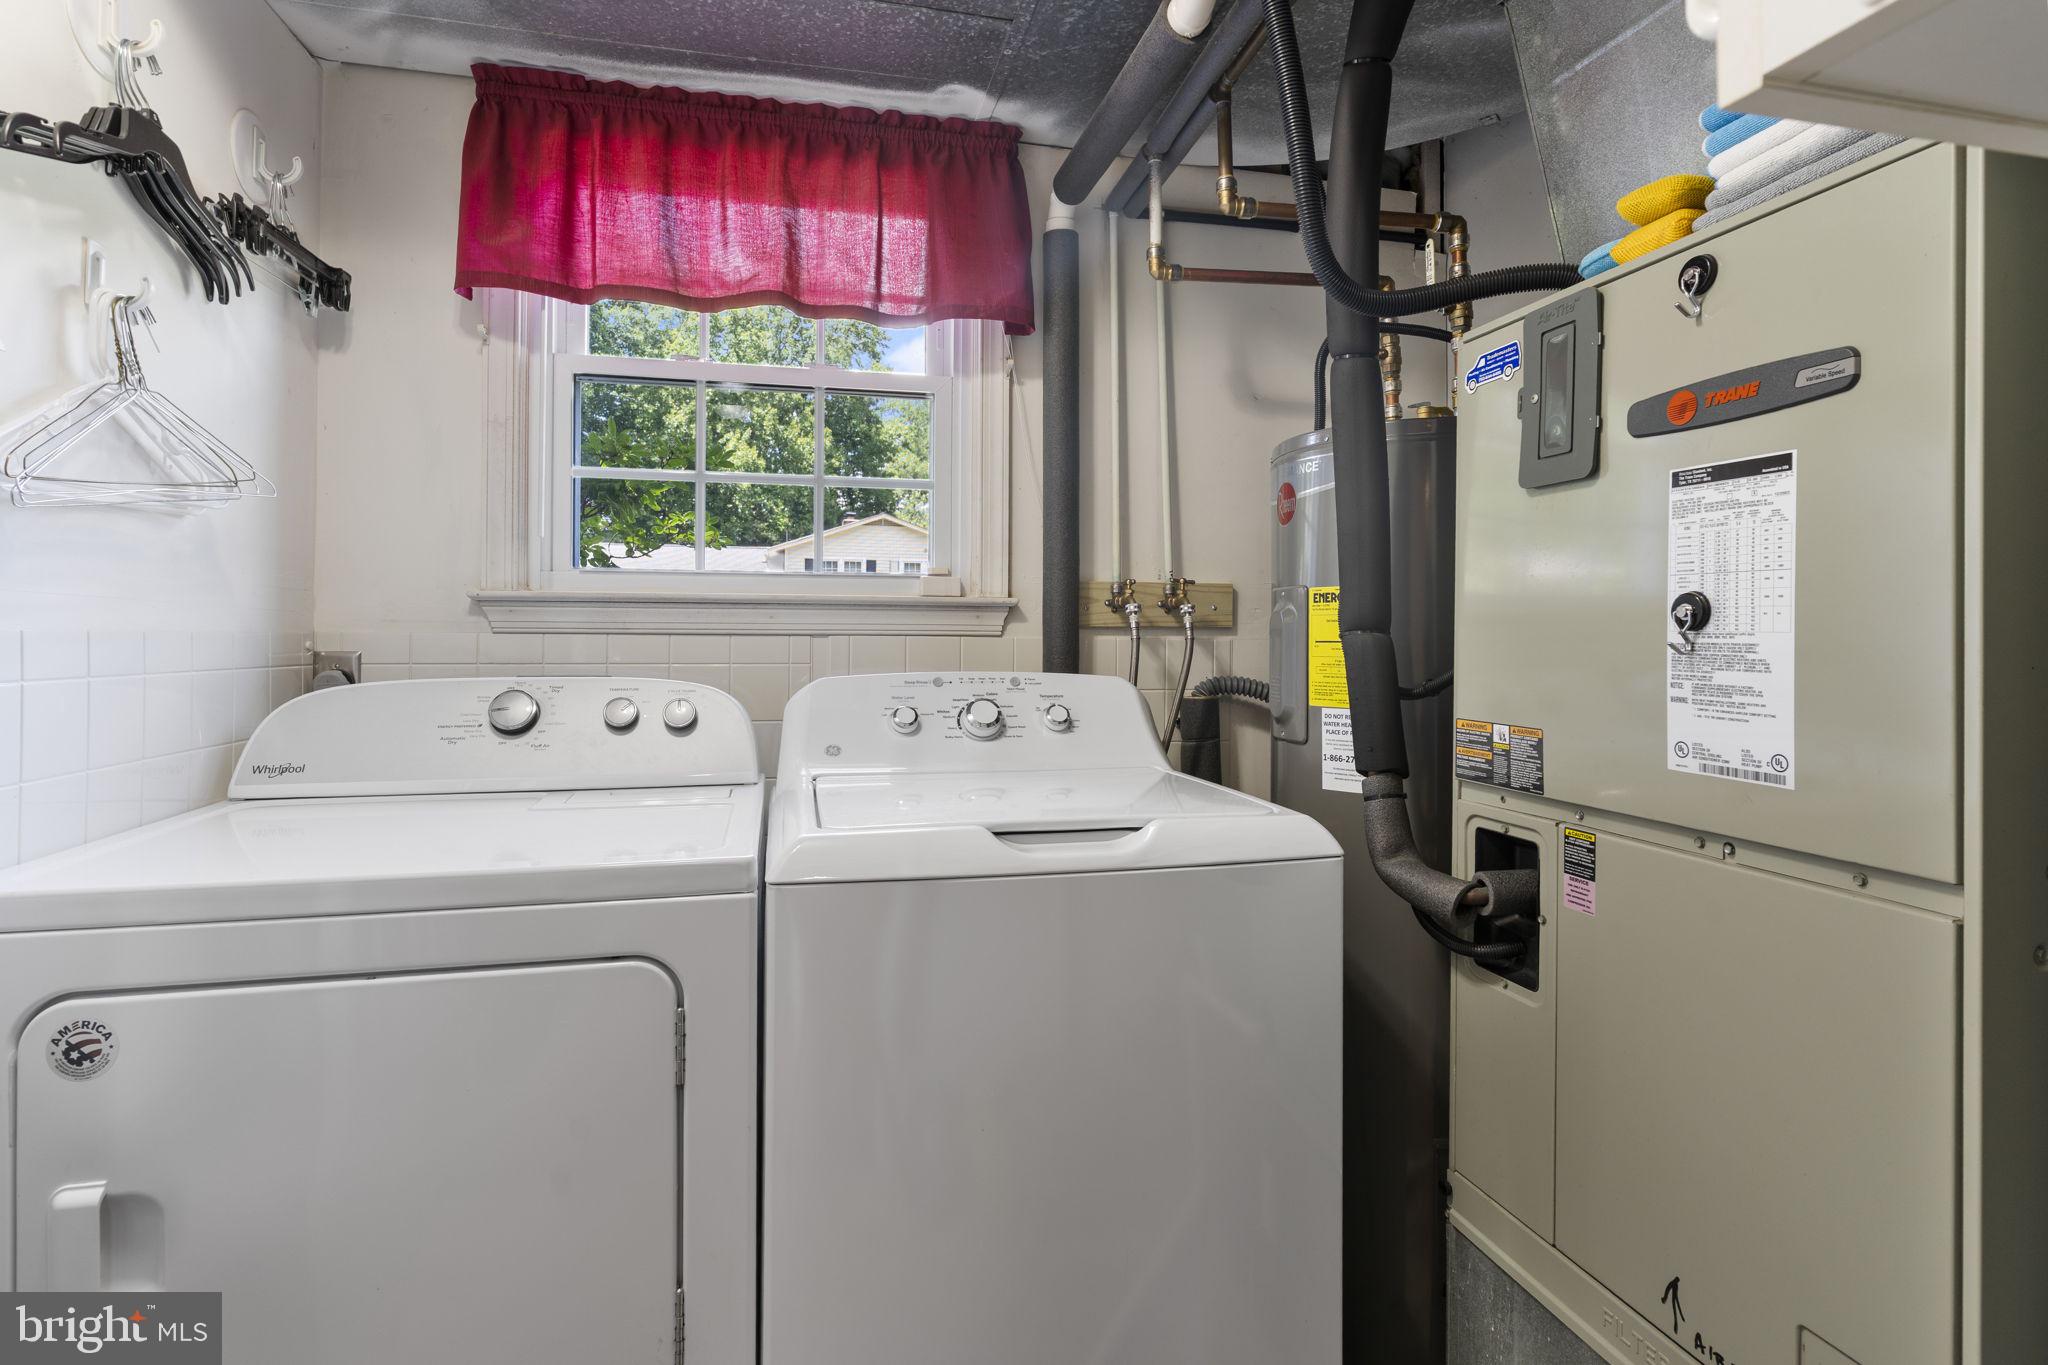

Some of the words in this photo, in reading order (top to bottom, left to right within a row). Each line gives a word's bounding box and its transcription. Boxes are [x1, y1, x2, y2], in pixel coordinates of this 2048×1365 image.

[1805, 371, 1827, 383] Variable
[1827, 367, 1846, 378] Speed
[1704, 380, 1761, 409] TRANE
[1466, 722, 1488, 730] WARNING
[1323, 754, 1355, 764] 1-866-27
[1774, 757, 1784, 769] UL
[252, 763, 304, 778] Whirlpool
[1572, 832, 1592, 840] CAUTION
[1569, 876, 1589, 886] SERVICE
[50, 1020, 113, 1048] AMERICA
